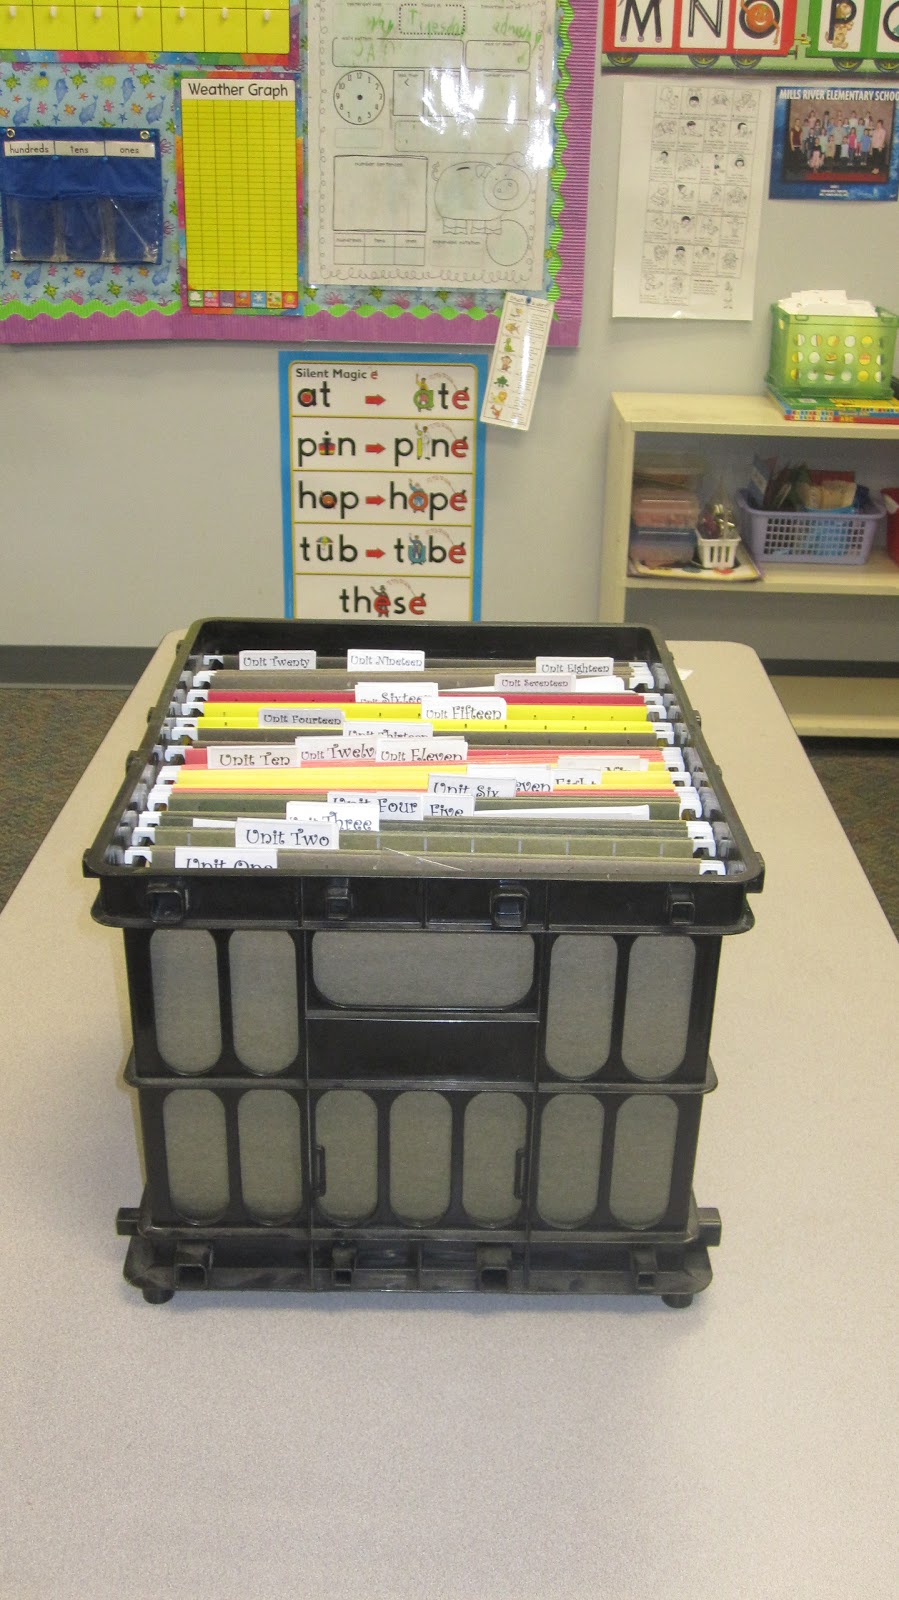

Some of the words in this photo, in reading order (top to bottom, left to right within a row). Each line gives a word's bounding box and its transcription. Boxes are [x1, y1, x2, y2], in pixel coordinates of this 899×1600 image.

[616, 0, 662, 42] M
[688, 0, 722, 38] N
[828, 0, 857, 41] P
[188, 83, 244, 96] Weather
[248, 83, 288, 99] Graph
[780, 89, 801, 100] MILLS
[802, 90, 825, 100] RIVER
[826, 90, 873, 101] ELEMENTARY
[875, 91, 899, 101] SCHOO
[9, 143, 49, 154] hundreds
[70, 145, 89, 154] tens
[296, 368, 329, 379] Silent
[333, 369, 367, 382] Magic
[297, 381, 331, 408] at
[412, 382, 470, 411] ate
[297, 431, 356, 467] pin
[394, 430, 469, 467] pine
[298, 480, 359, 519] hop
[389, 480, 468, 520] hope
[300, 534, 358, 562] tub
[394, 535, 467, 565] tube
[339, 585, 427, 617] these
[243, 656, 267, 667] Unit
[271, 655, 310, 668] Twenty
[351, 655, 373, 666] Unit
[375, 655, 423, 667] Nineteen
[541, 663, 564, 673] Unit
[567, 663, 610, 675] Eighteen
[501, 679, 521, 687] Unit
[524, 679, 569, 688] Seventeen
[381, 692, 423, 703] Sixtee
[263, 714, 288, 724] Unit
[292, 715, 342, 725] Fourteen
[426, 708, 448, 719] Unit
[452, 706, 502, 720] Fifteen
[220, 753, 255, 766] Unit
[260, 751, 290, 766] Ten
[301, 750, 324, 761] Unit
[327, 744, 376, 760] Twelv
[381, 751, 406, 761] Unit
[411, 749, 463, 761] Eleven
[433, 781, 470, 793] Unit
[476, 784, 500, 797] Six
[516, 782, 551, 792] even
[377, 798, 418, 813] Four
[430, 803, 464, 816] Five
[322, 811, 373, 831] Three
[246, 829, 285, 845] Unit
[290, 828, 330, 846] Two
[186, 858, 227, 868] Unit
